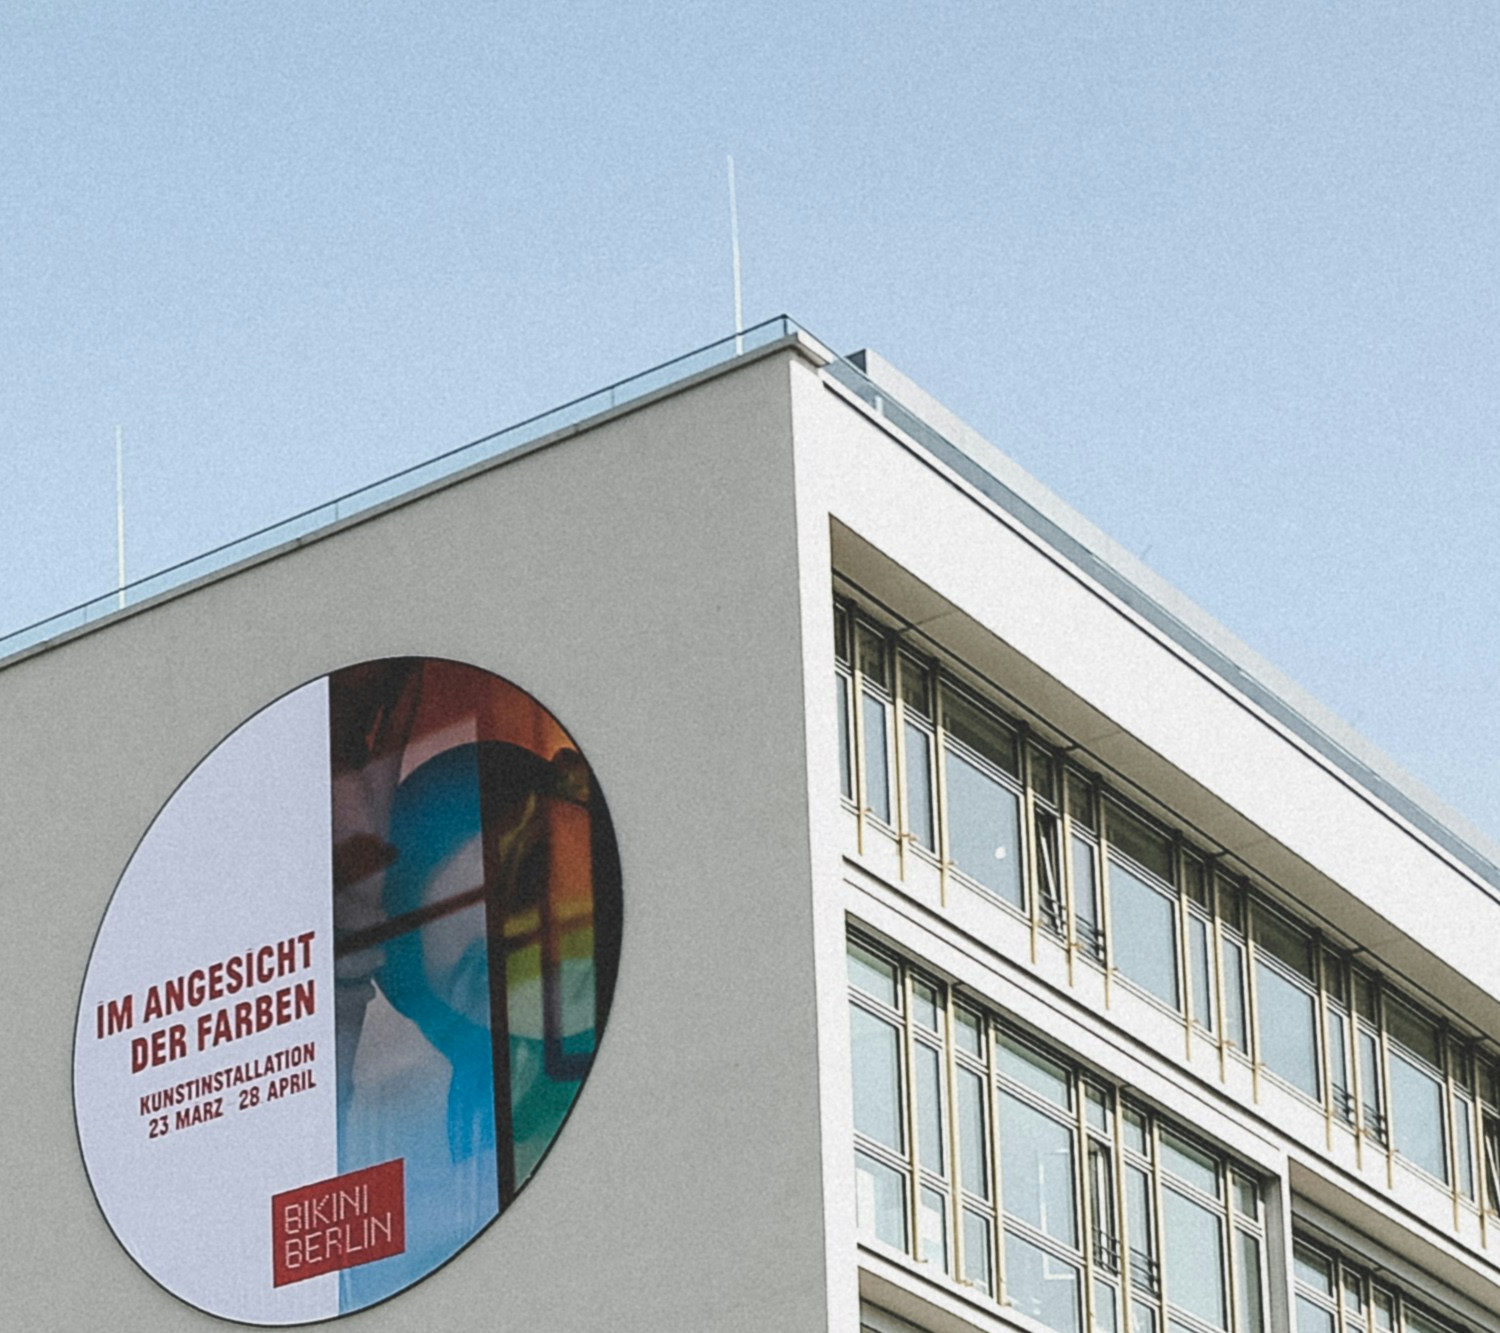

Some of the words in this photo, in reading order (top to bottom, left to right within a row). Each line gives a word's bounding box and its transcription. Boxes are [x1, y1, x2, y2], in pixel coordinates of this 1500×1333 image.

[97, 994, 133, 1040] IM
[143, 931, 315, 1023] ANGESICHT
[131, 1024, 187, 1074] DER
[198, 980, 315, 1051] FARBEN
[140, 1042, 315, 1116] KUNSTINSTALLATION
[267, 1069, 316, 1101] APRIL
[285, 1184, 368, 1235] BIKINI
[285, 1212, 391, 1269] BERLIN
